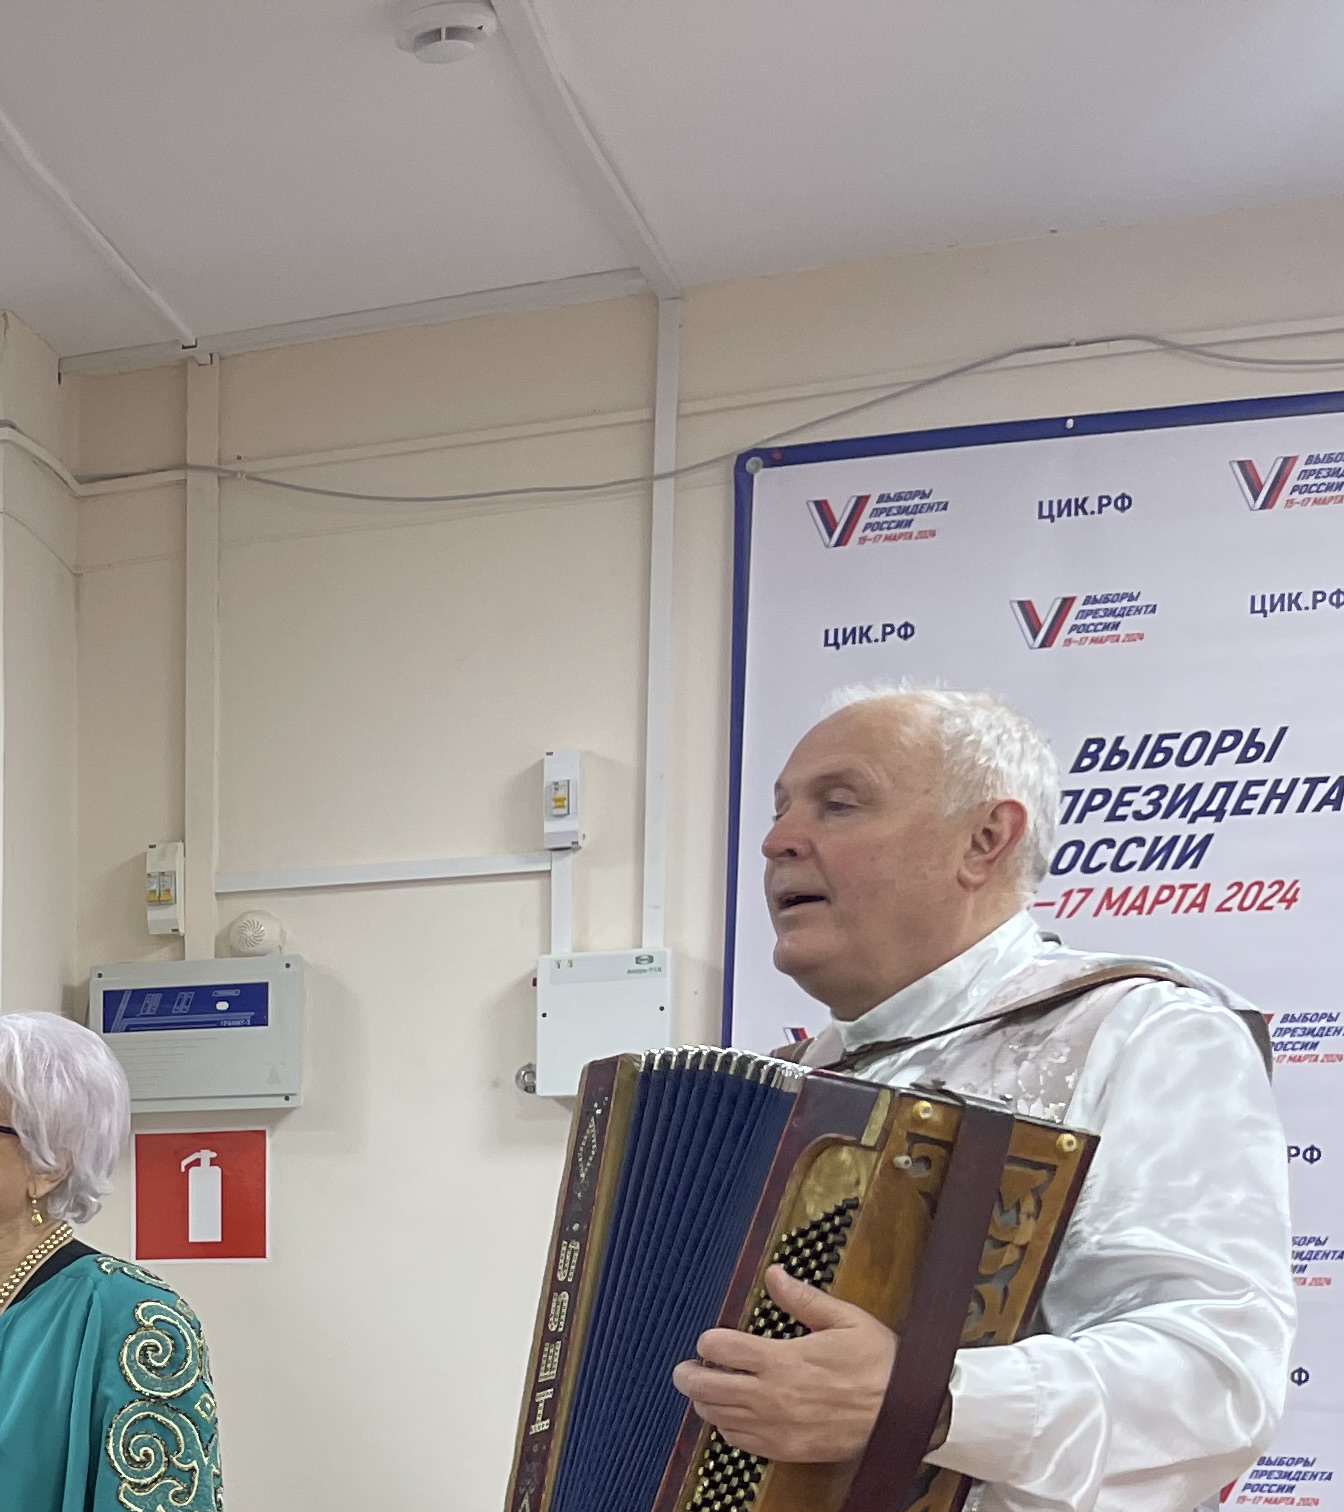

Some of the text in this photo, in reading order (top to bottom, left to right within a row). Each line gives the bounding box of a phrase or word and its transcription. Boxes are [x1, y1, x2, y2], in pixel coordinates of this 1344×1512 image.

[1304, 452, 1344, 466] ВЫБО
[876, 488, 933, 504] ВЫБОРЫ
[869, 501, 949, 519] ПРЕЗИДЕНТА
[1037, 492, 1132, 523] ЦИК.РФ
[862, 518, 914, 533] РОССИИ
[1082, 591, 1141, 606] ВЫБОРЫ
[1250, 588, 1344, 618] ЦИК.РФ
[1075, 604, 1157, 620] ПРЕЗИДЕНТА
[1067, 621, 1121, 635] РОССИИ
[823, 621, 915, 651] ЦИК.РФ
[1069, 726, 1289, 774] ВЫБОРЫ
[1059, 775, 1344, 825] ПРЕЗИДЕНТА
[1049, 833, 1214, 875] ОССИИ
[1033, 879, 1301, 919] –17 МАРТА 2024
[1280, 1012, 1341, 1023] ВЫБОРЫ
[1272, 1026, 1344, 1038] ПРЕЗИДЕН
[1292, 1236, 1329, 1247] БОРЫ
[1292, 1250, 1344, 1261] ИДЕНТА
[1257, 1456, 1317, 1467] ВЫБОРЫ
[1249, 1470, 1333, 1481] ПРЕЗИДЕНТА
[1241, 1483, 1296, 1493] РОССИИ
